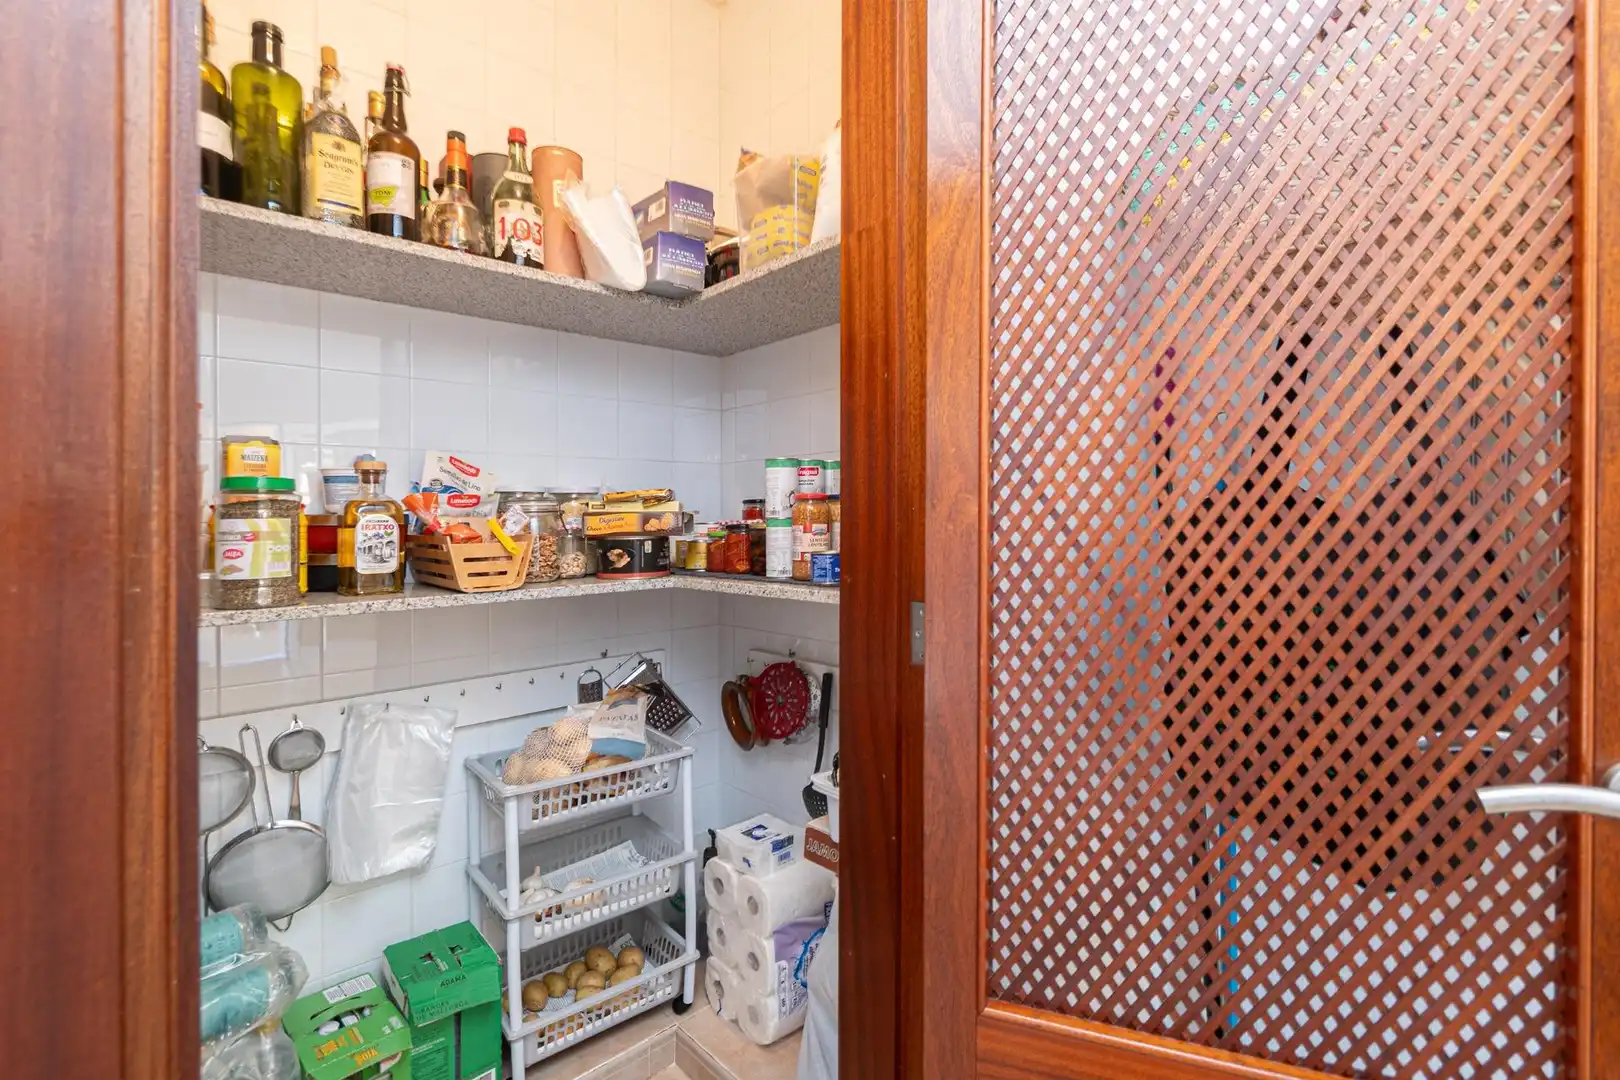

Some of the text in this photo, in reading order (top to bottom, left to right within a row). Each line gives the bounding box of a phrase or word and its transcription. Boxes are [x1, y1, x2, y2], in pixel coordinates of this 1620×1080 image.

[499, 216, 543, 247] 103
[241, 454, 268, 462] MAIZENA
[361, 523, 395, 531] IRATXO
